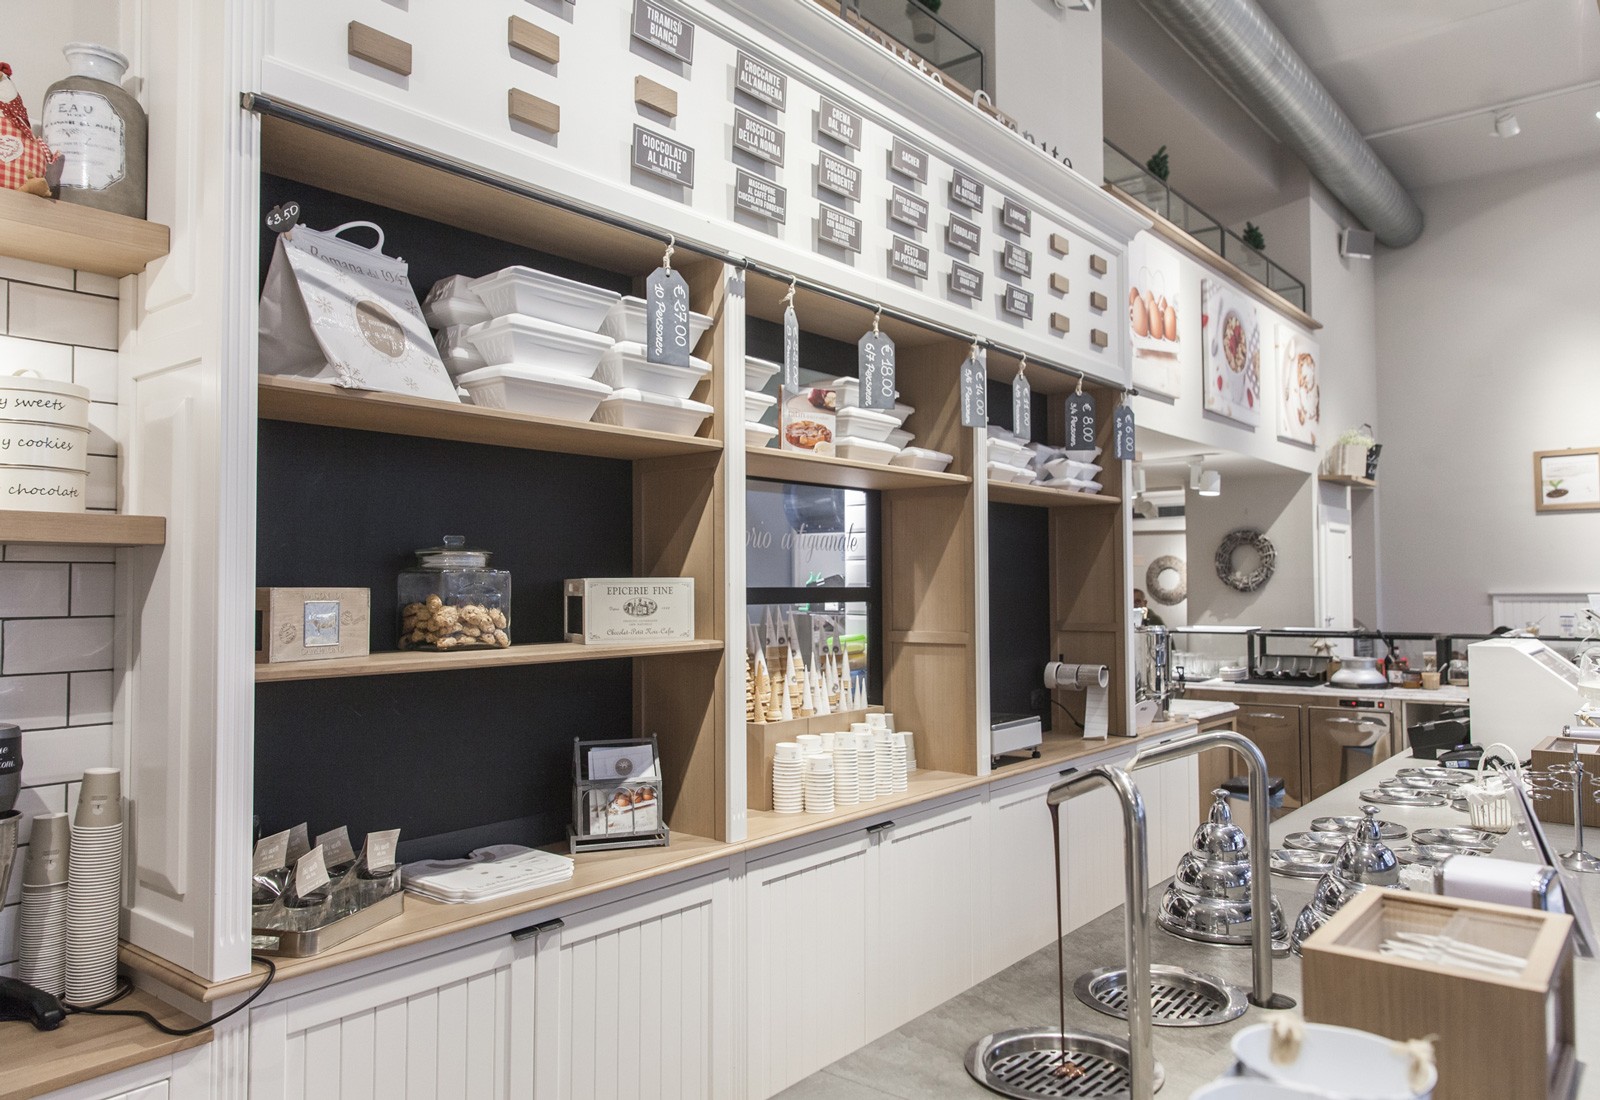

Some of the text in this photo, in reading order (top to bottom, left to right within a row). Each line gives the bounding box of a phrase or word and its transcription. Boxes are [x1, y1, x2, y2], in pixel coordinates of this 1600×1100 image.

[650, 22, 678, 46] BIANCO
[740, 70, 783, 101] ALL'AMARENA
[744, 60, 781, 88] CROCCANTE
[58, 103, 93, 114] EAU
[832, 107, 850, 126] CREMA
[745, 118, 775, 143] BISCOTTO
[828, 116, 839, 131] DAL
[840, 123, 853, 139] 1947
[642, 134, 687, 163] CIOCCOLATO
[738, 127, 758, 147] DELLA
[759, 137, 781, 158] NONNA
[647, 150, 658, 165] AL
[659, 154, 682, 174] LATTE
[825, 157, 857, 182] CIOCCOLATO
[826, 170, 855, 192] FONDENTE
[266, 204, 299, 226] €3.50
[655, 301, 666, 356] Personen
[14, 397, 66, 411] sweets
[17, 437, 74, 451] cookies
[8, 484, 80, 498] chocolate
[781, 522, 858, 563] artigianale
[607, 586, 674, 595] EPICERIE FINE
